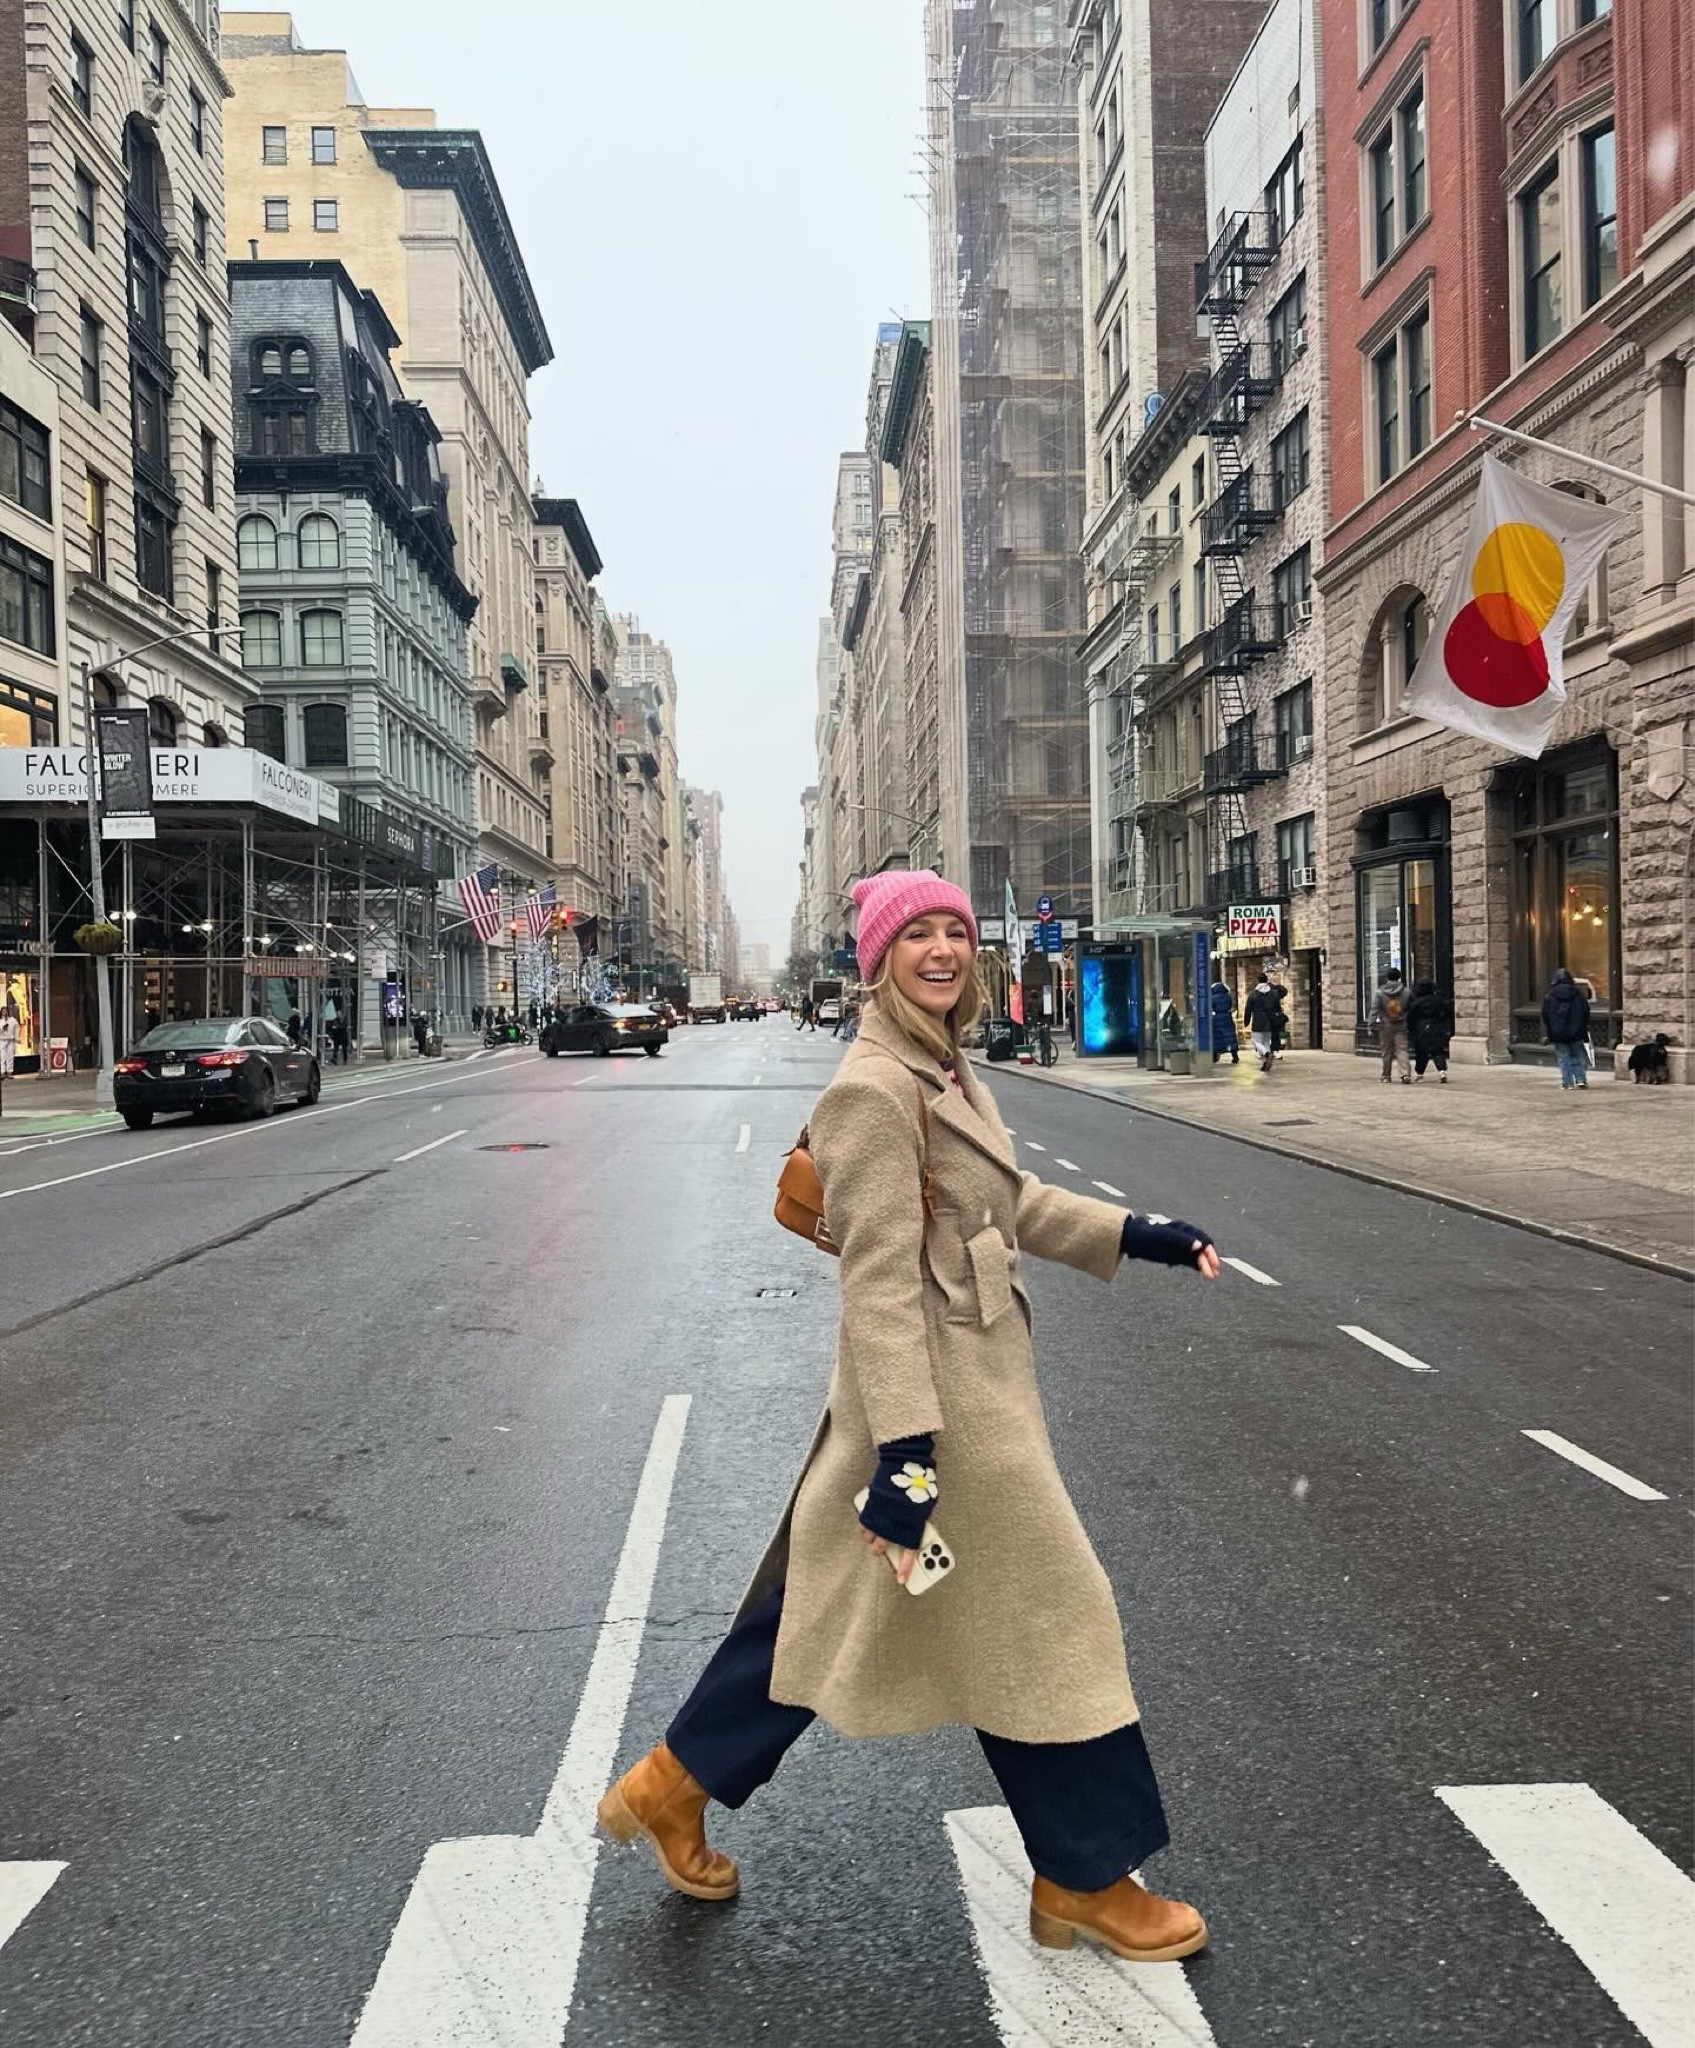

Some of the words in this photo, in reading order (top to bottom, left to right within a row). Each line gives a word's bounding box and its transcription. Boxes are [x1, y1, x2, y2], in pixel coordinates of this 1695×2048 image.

[26, 754, 199, 777] FALCERI
[103, 753, 132, 763] WINTER
[104, 762, 126, 771] GLOW
[262, 763, 312, 800] FALCONERI
[387, 826, 415, 852] SEPHORA
[1233, 907, 1275, 918] ROMA
[1230, 918, 1278, 935] PIZZA
